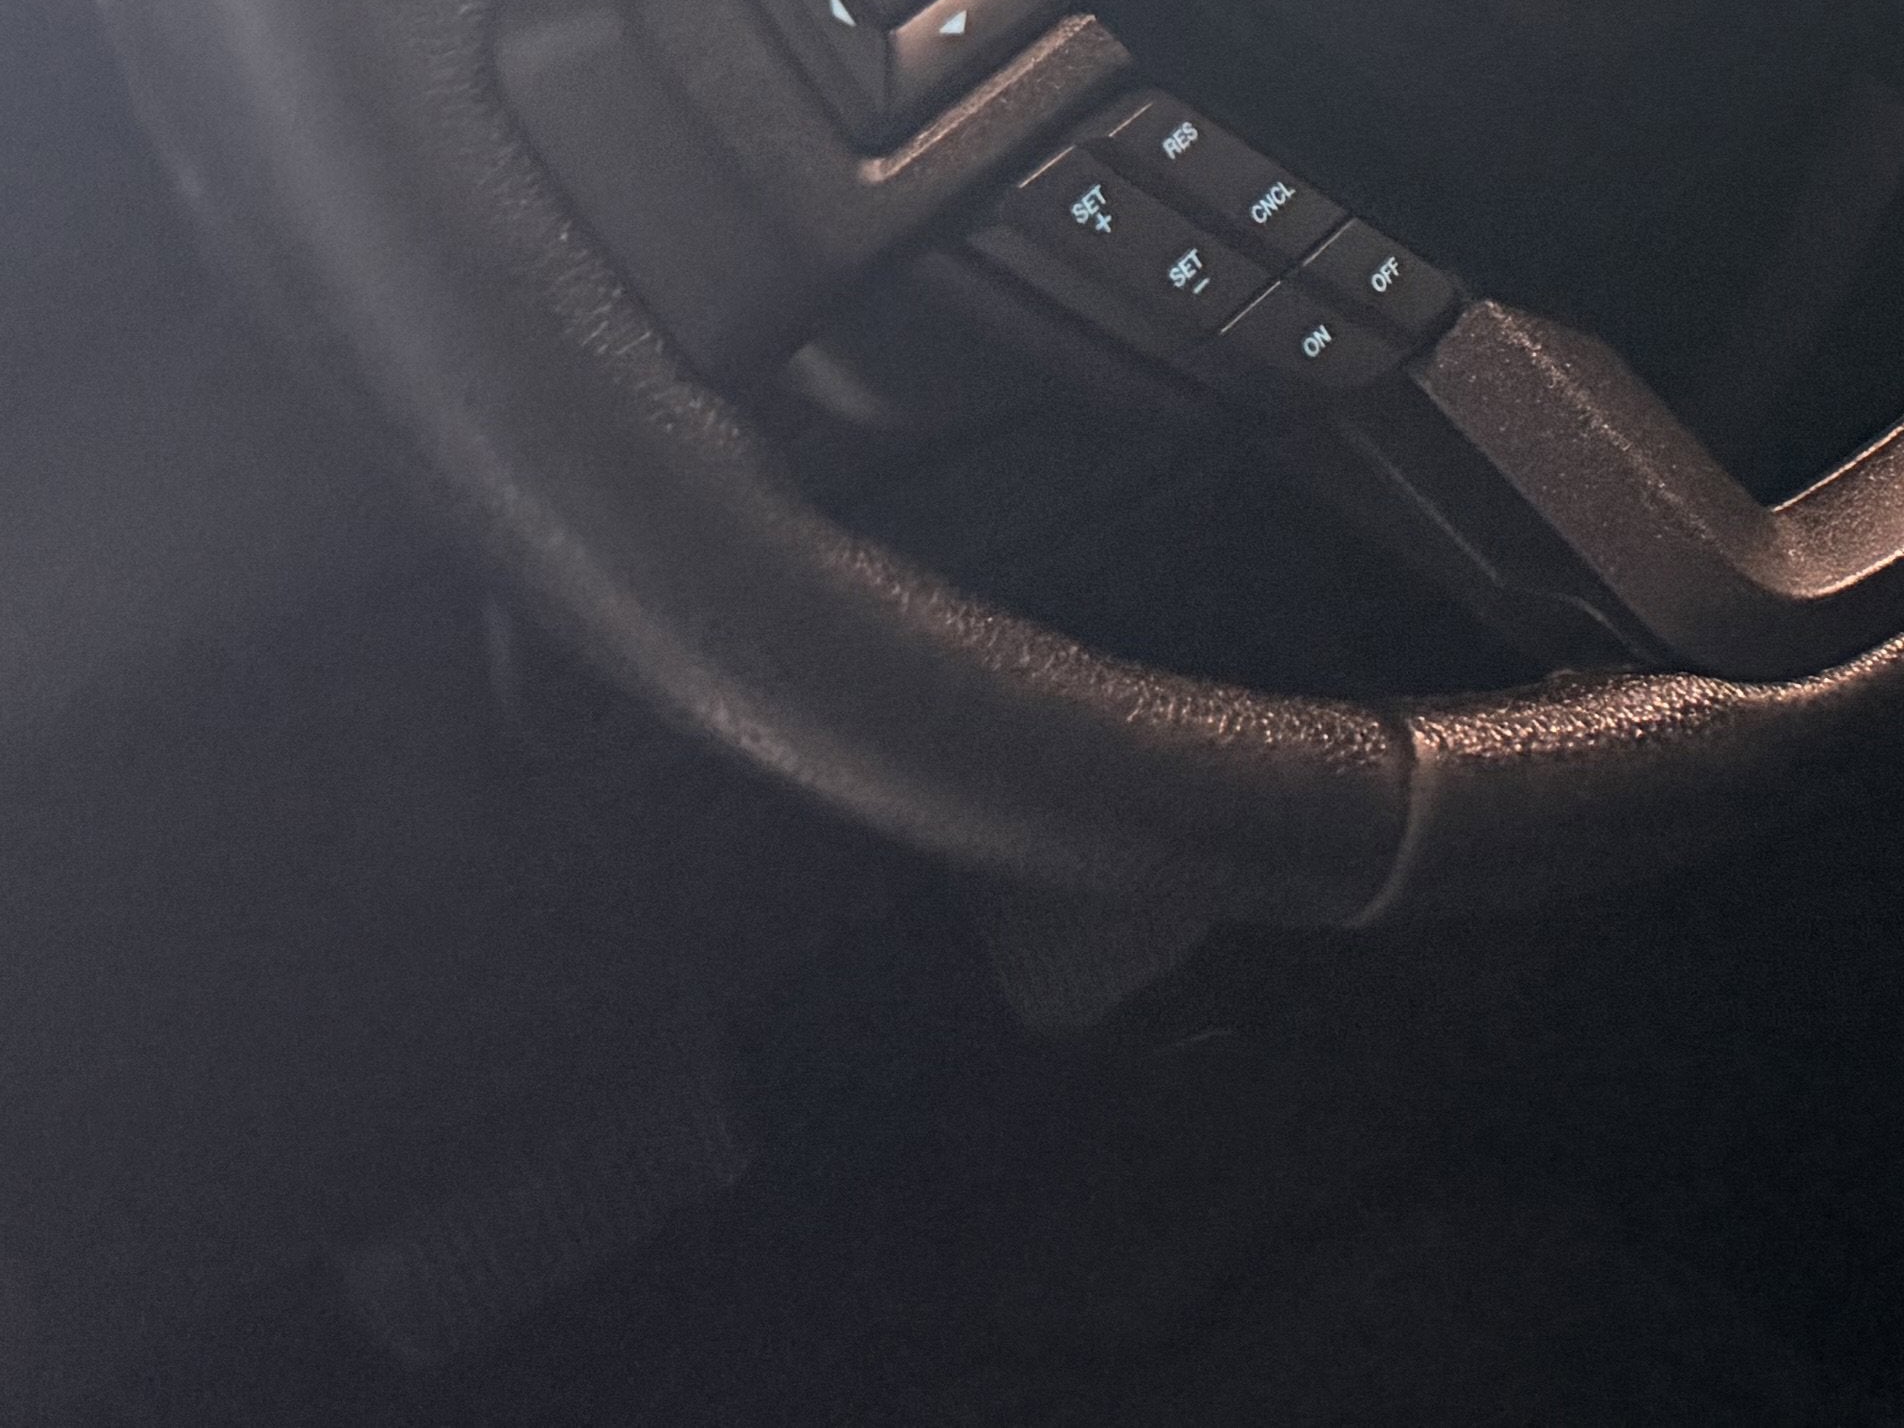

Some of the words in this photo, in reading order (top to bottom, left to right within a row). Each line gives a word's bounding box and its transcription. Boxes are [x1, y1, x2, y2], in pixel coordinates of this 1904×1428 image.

[1162, 121, 1199, 159] RES
[1071, 184, 1107, 225] SET
[1250, 181, 1296, 224] CNCL
[1168, 248, 1205, 288] SET
[1370, 256, 1401, 293] OFF
[1302, 324, 1333, 358] ON
